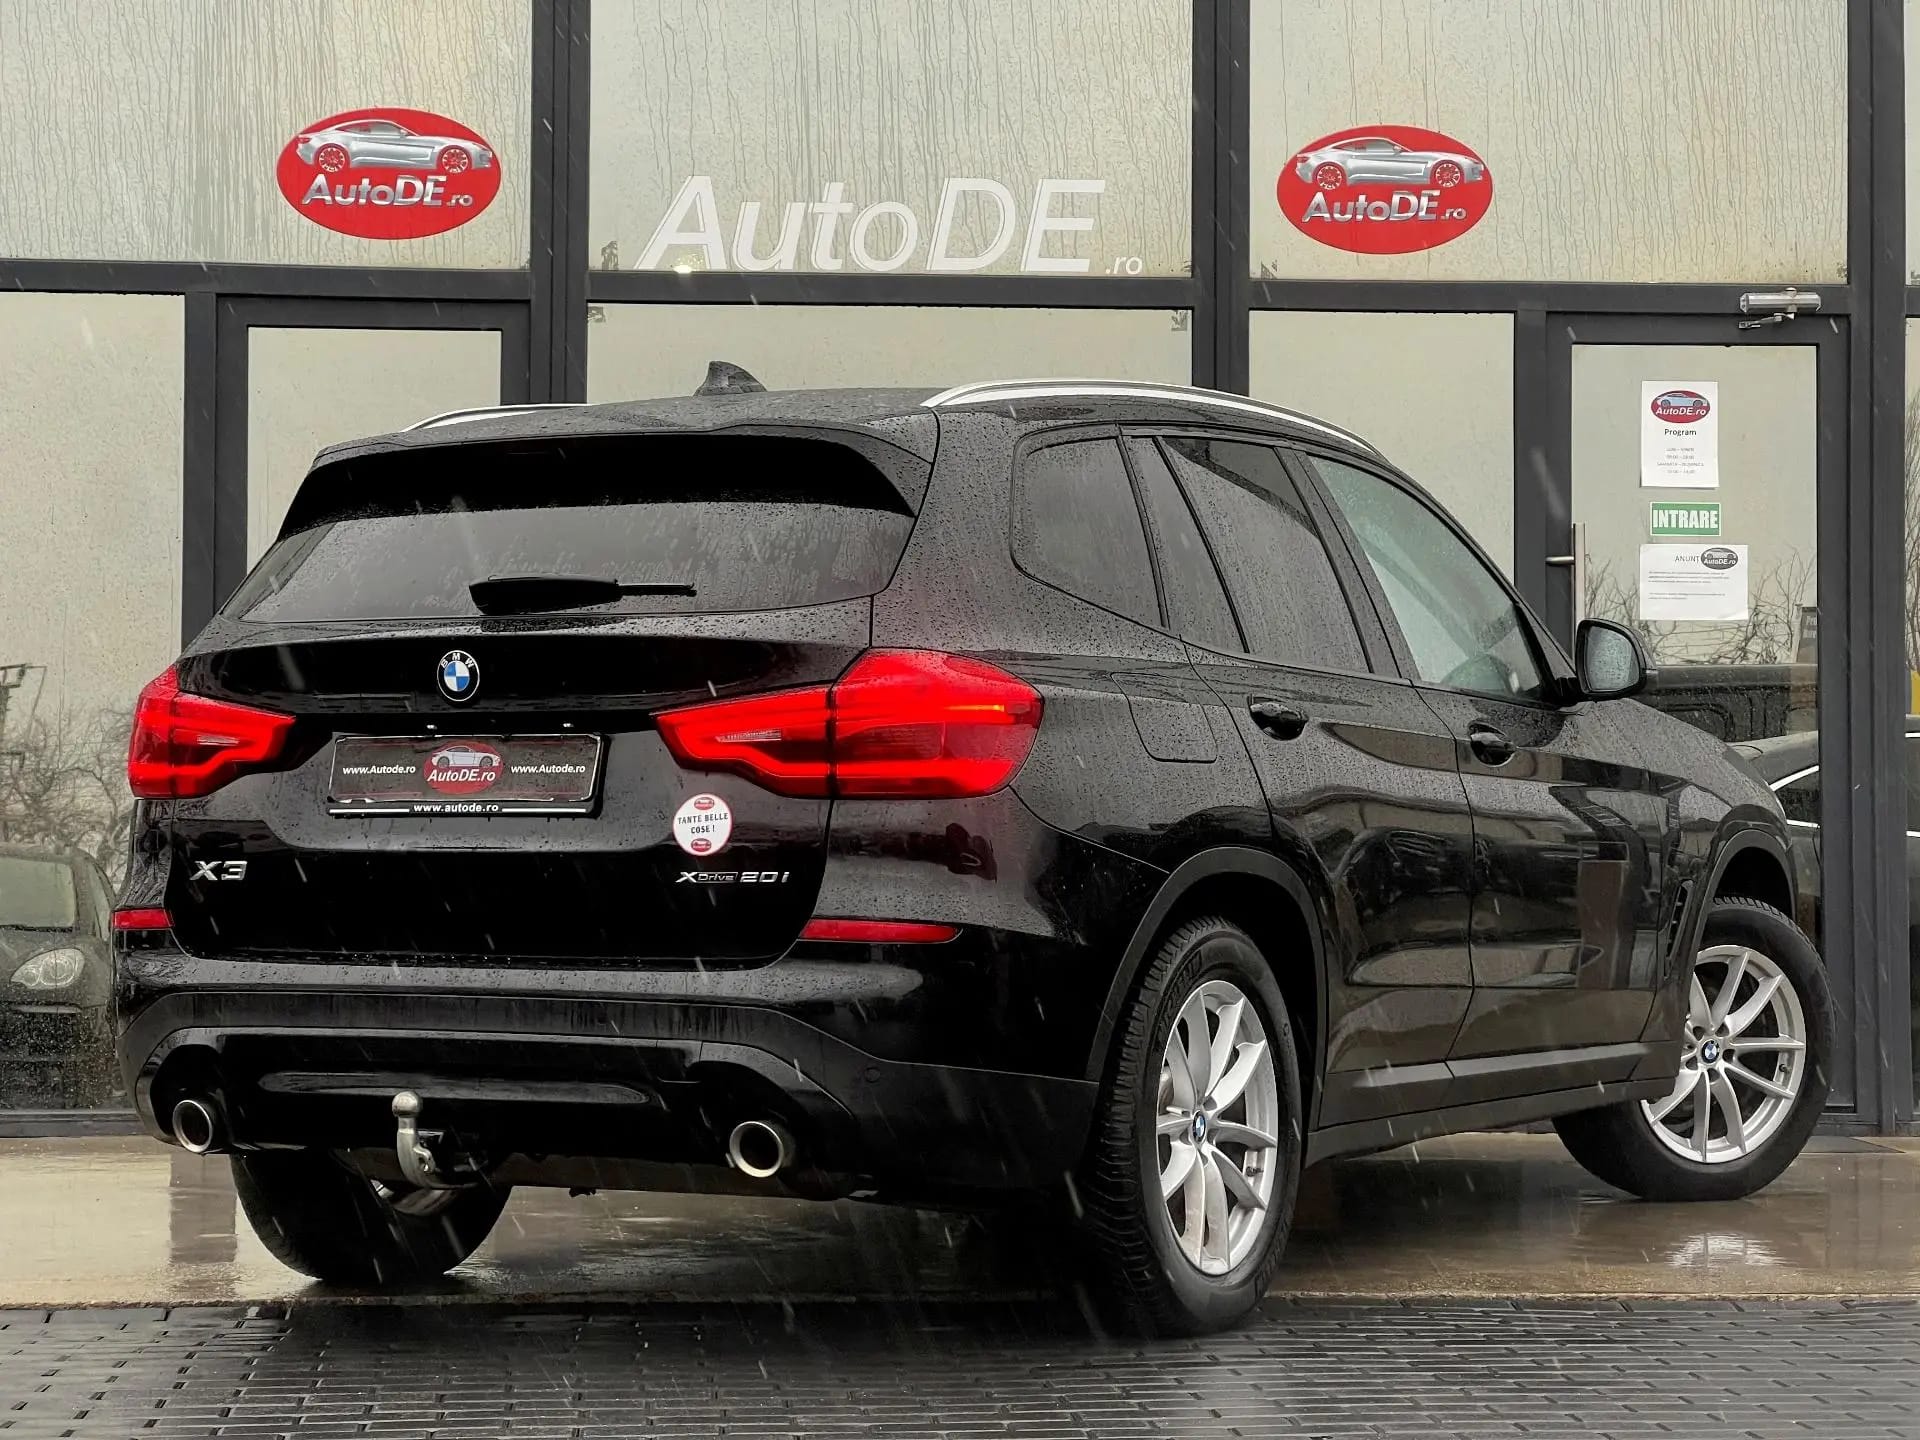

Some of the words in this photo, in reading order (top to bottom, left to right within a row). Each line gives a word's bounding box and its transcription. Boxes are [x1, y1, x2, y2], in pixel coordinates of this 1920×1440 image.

[1664, 429, 1697, 437] Program
[1652, 509, 1719, 529] INTRARE
[342, 764, 417, 775] www.Autode.ro
[510, 763, 587, 774] www.Autode.ro
[427, 769, 497, 782] AutoDE.ro
[413, 803, 500, 813] www.autode.ro
[677, 815, 703, 825] TANTE
[690, 825, 711, 834] COSE
[189, 860, 248, 881] X3
